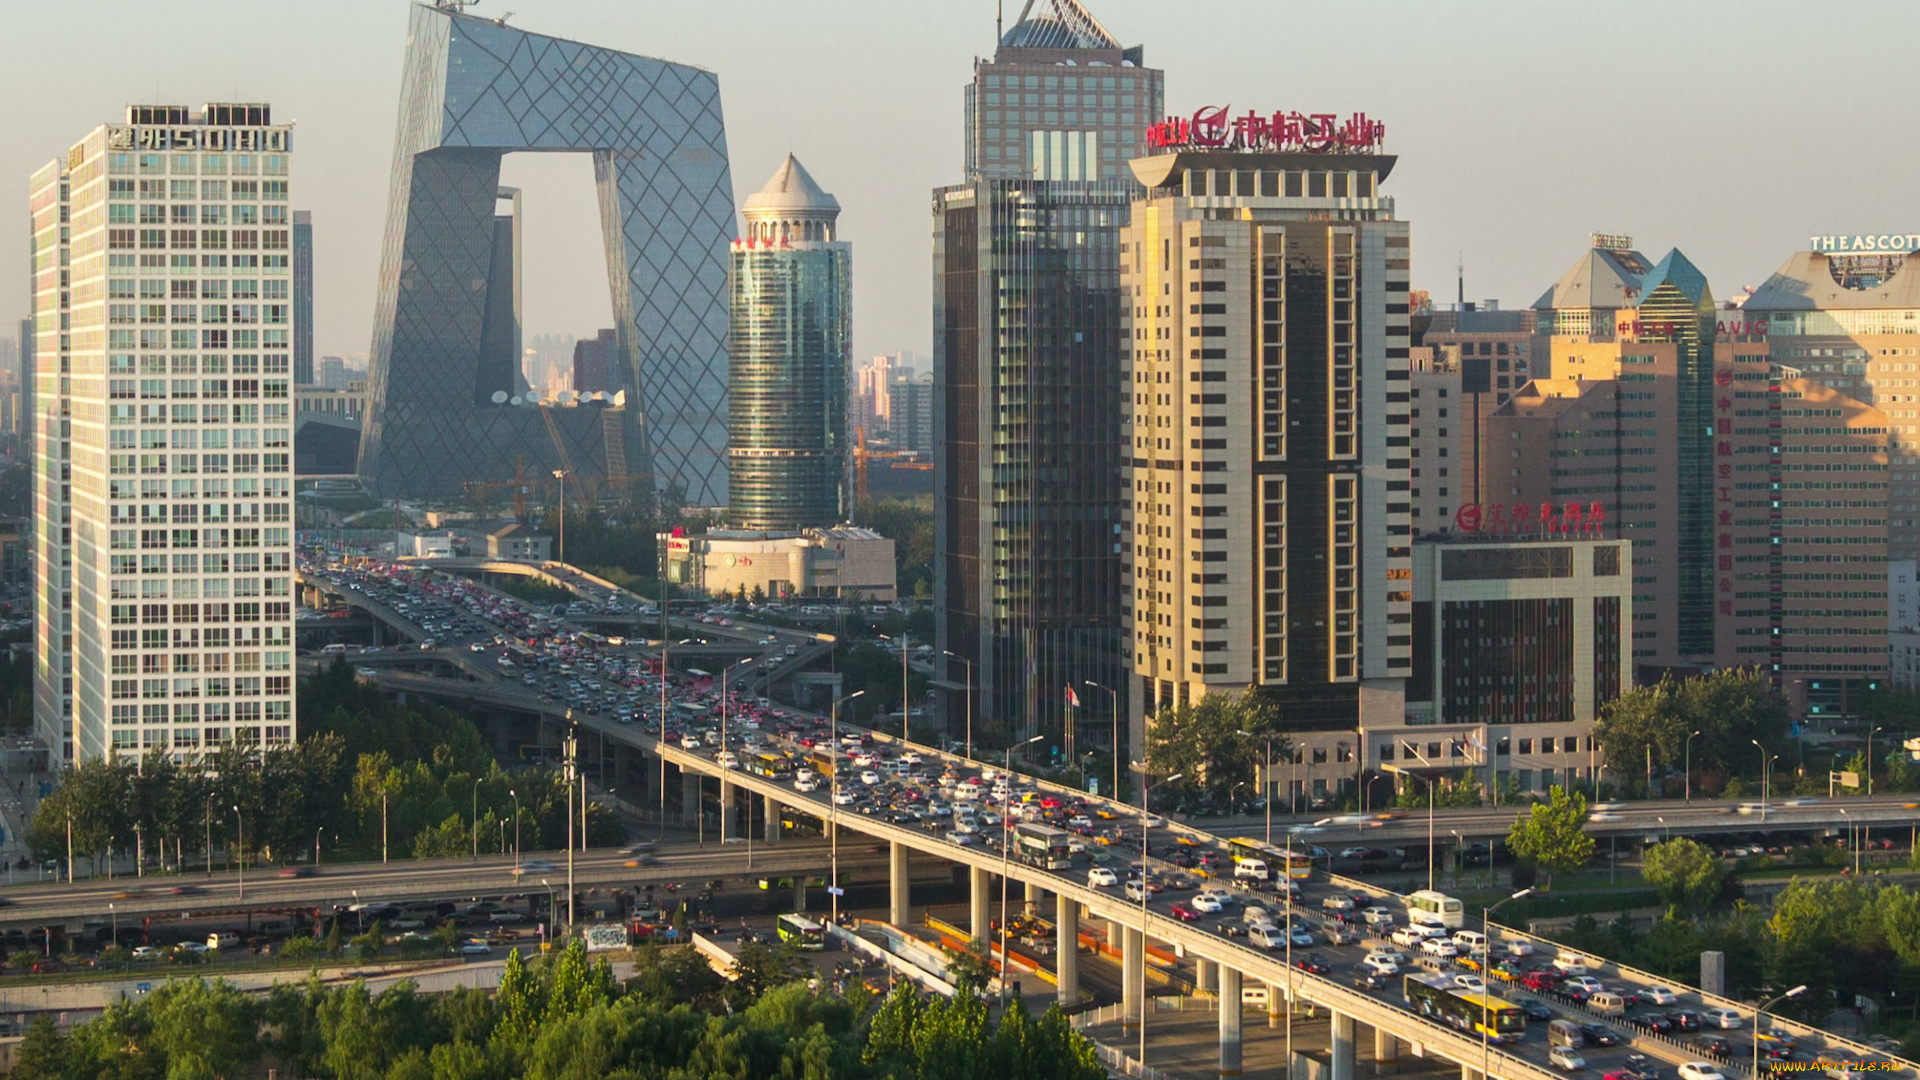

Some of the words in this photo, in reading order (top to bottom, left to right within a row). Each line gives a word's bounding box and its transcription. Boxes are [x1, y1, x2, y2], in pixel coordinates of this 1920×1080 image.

[1236, 109, 1374, 150] 中航工业
[1810, 236, 1849, 250] THE
[1715, 320, 1767, 335] AVIC
